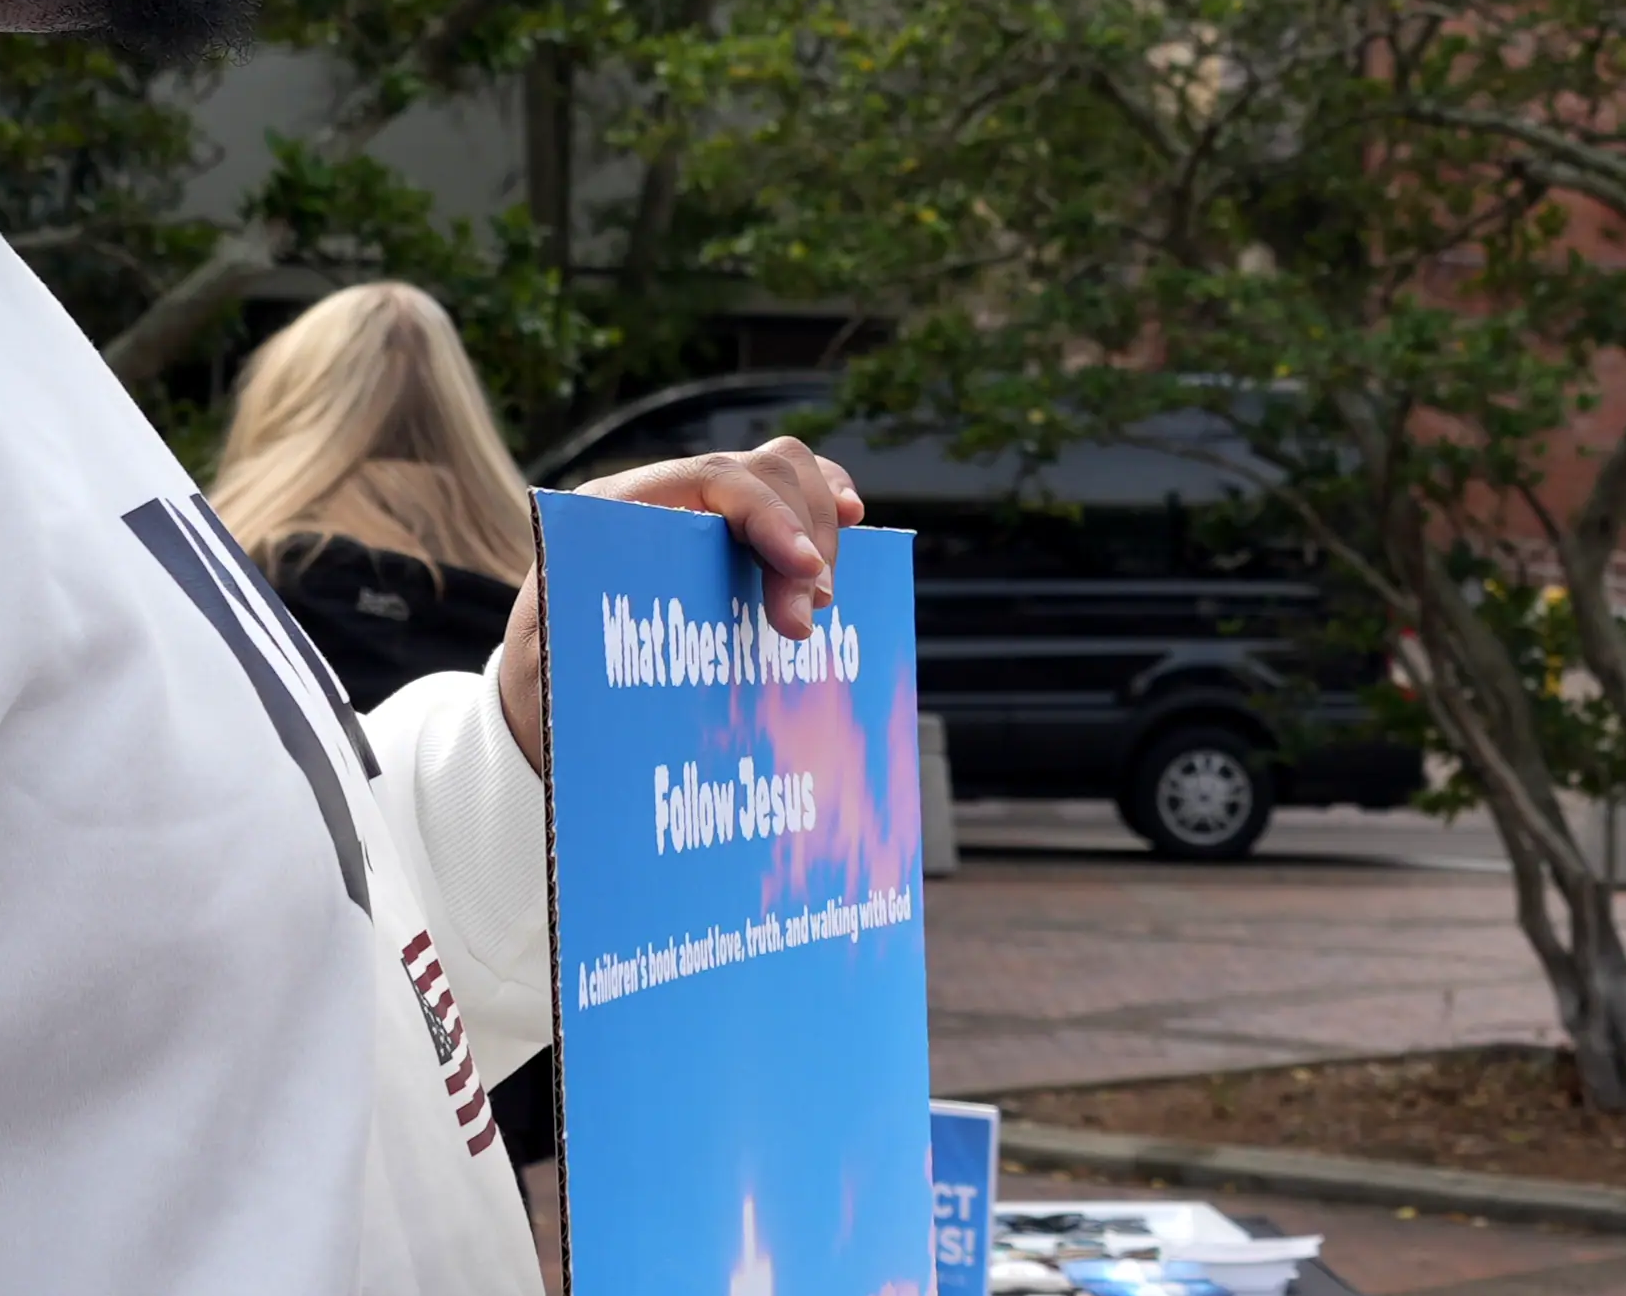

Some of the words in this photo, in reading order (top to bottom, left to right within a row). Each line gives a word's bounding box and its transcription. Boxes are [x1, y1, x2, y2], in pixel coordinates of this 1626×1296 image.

[602, 591, 666, 688] What
[668, 597, 730, 686] Does
[732, 597, 755, 685] it
[757, 602, 827, 685] Mean
[829, 605, 859, 683] to
[654, 763, 734, 855] Follow
[738, 756, 816, 841] Jesus
[579, 962, 588, 1012] A
[589, 946, 647, 1006] children's
[648, 935, 678, 988] book
[679, 926, 714, 977] about
[715, 924, 745, 967] love,
[746, 912, 784, 958] truth,
[785, 904, 808, 948] and
[810, 895, 859, 944] walking
[859, 890, 887, 930] with
[888, 885, 911, 924] God
[932, 1182, 978, 1221] CT
